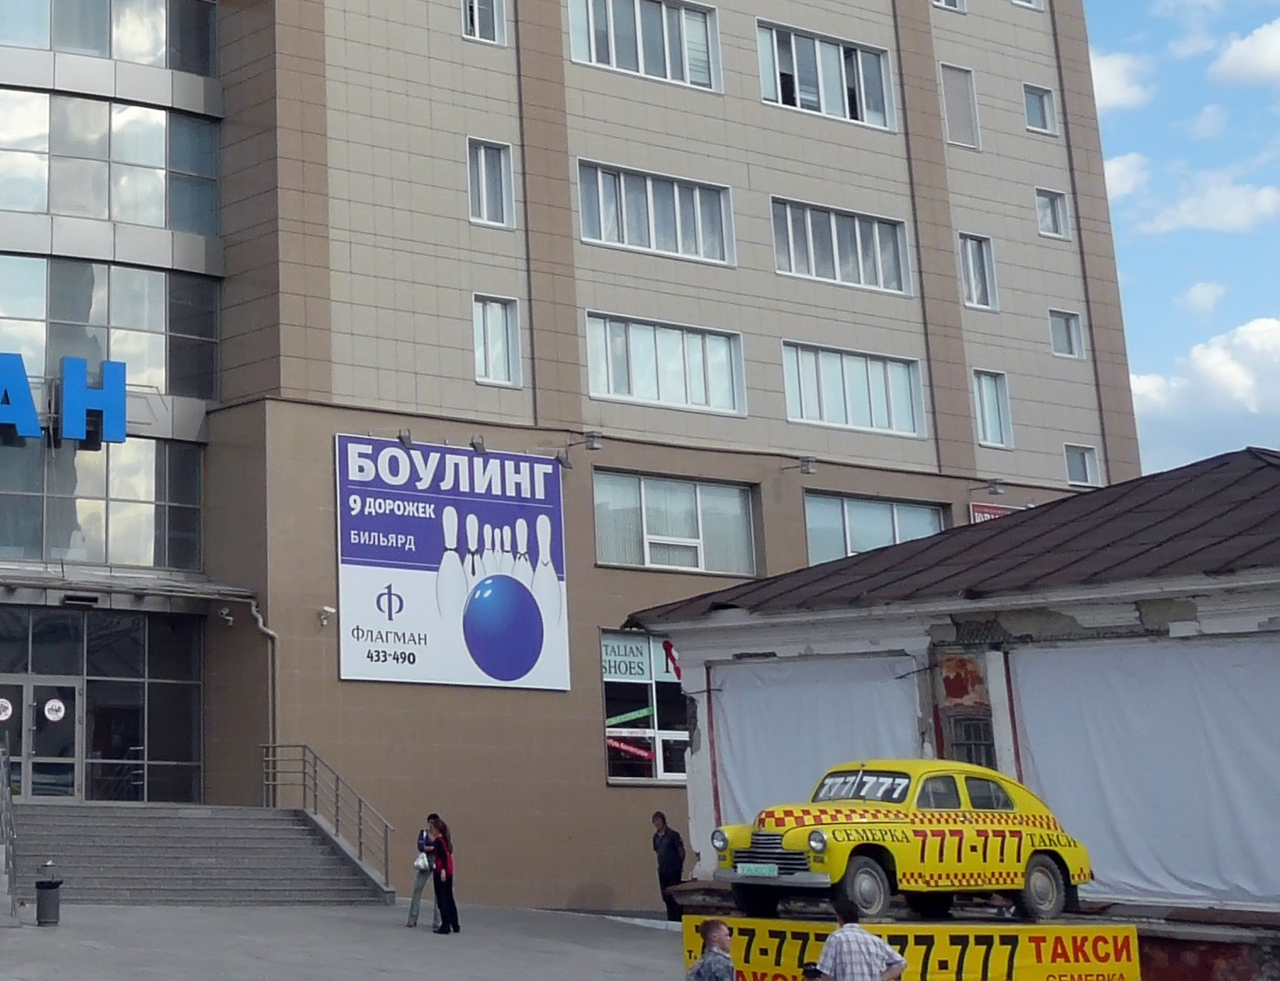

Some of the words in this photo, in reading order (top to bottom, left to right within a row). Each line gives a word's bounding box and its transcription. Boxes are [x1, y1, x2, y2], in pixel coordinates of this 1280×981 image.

[346, 442, 553, 500] БОУЛИНГ
[348, 494, 362, 516] 9
[364, 497, 435, 519] ДОРОЖЕК
[350, 530, 416, 552] БИЛЬЯРД
[351, 625, 428, 646] ФЛАГМАН
[366, 649, 416, 665] 433-490
[602, 644, 644, 658] TALIAN
[832, 828, 910, 843] СЕМЕРКА
[912, 829, 1023, 864] 777-777
[1026, 832, 1078, 849] ТАКСИ
[1028, 935, 1132, 964] ТАКСИ
